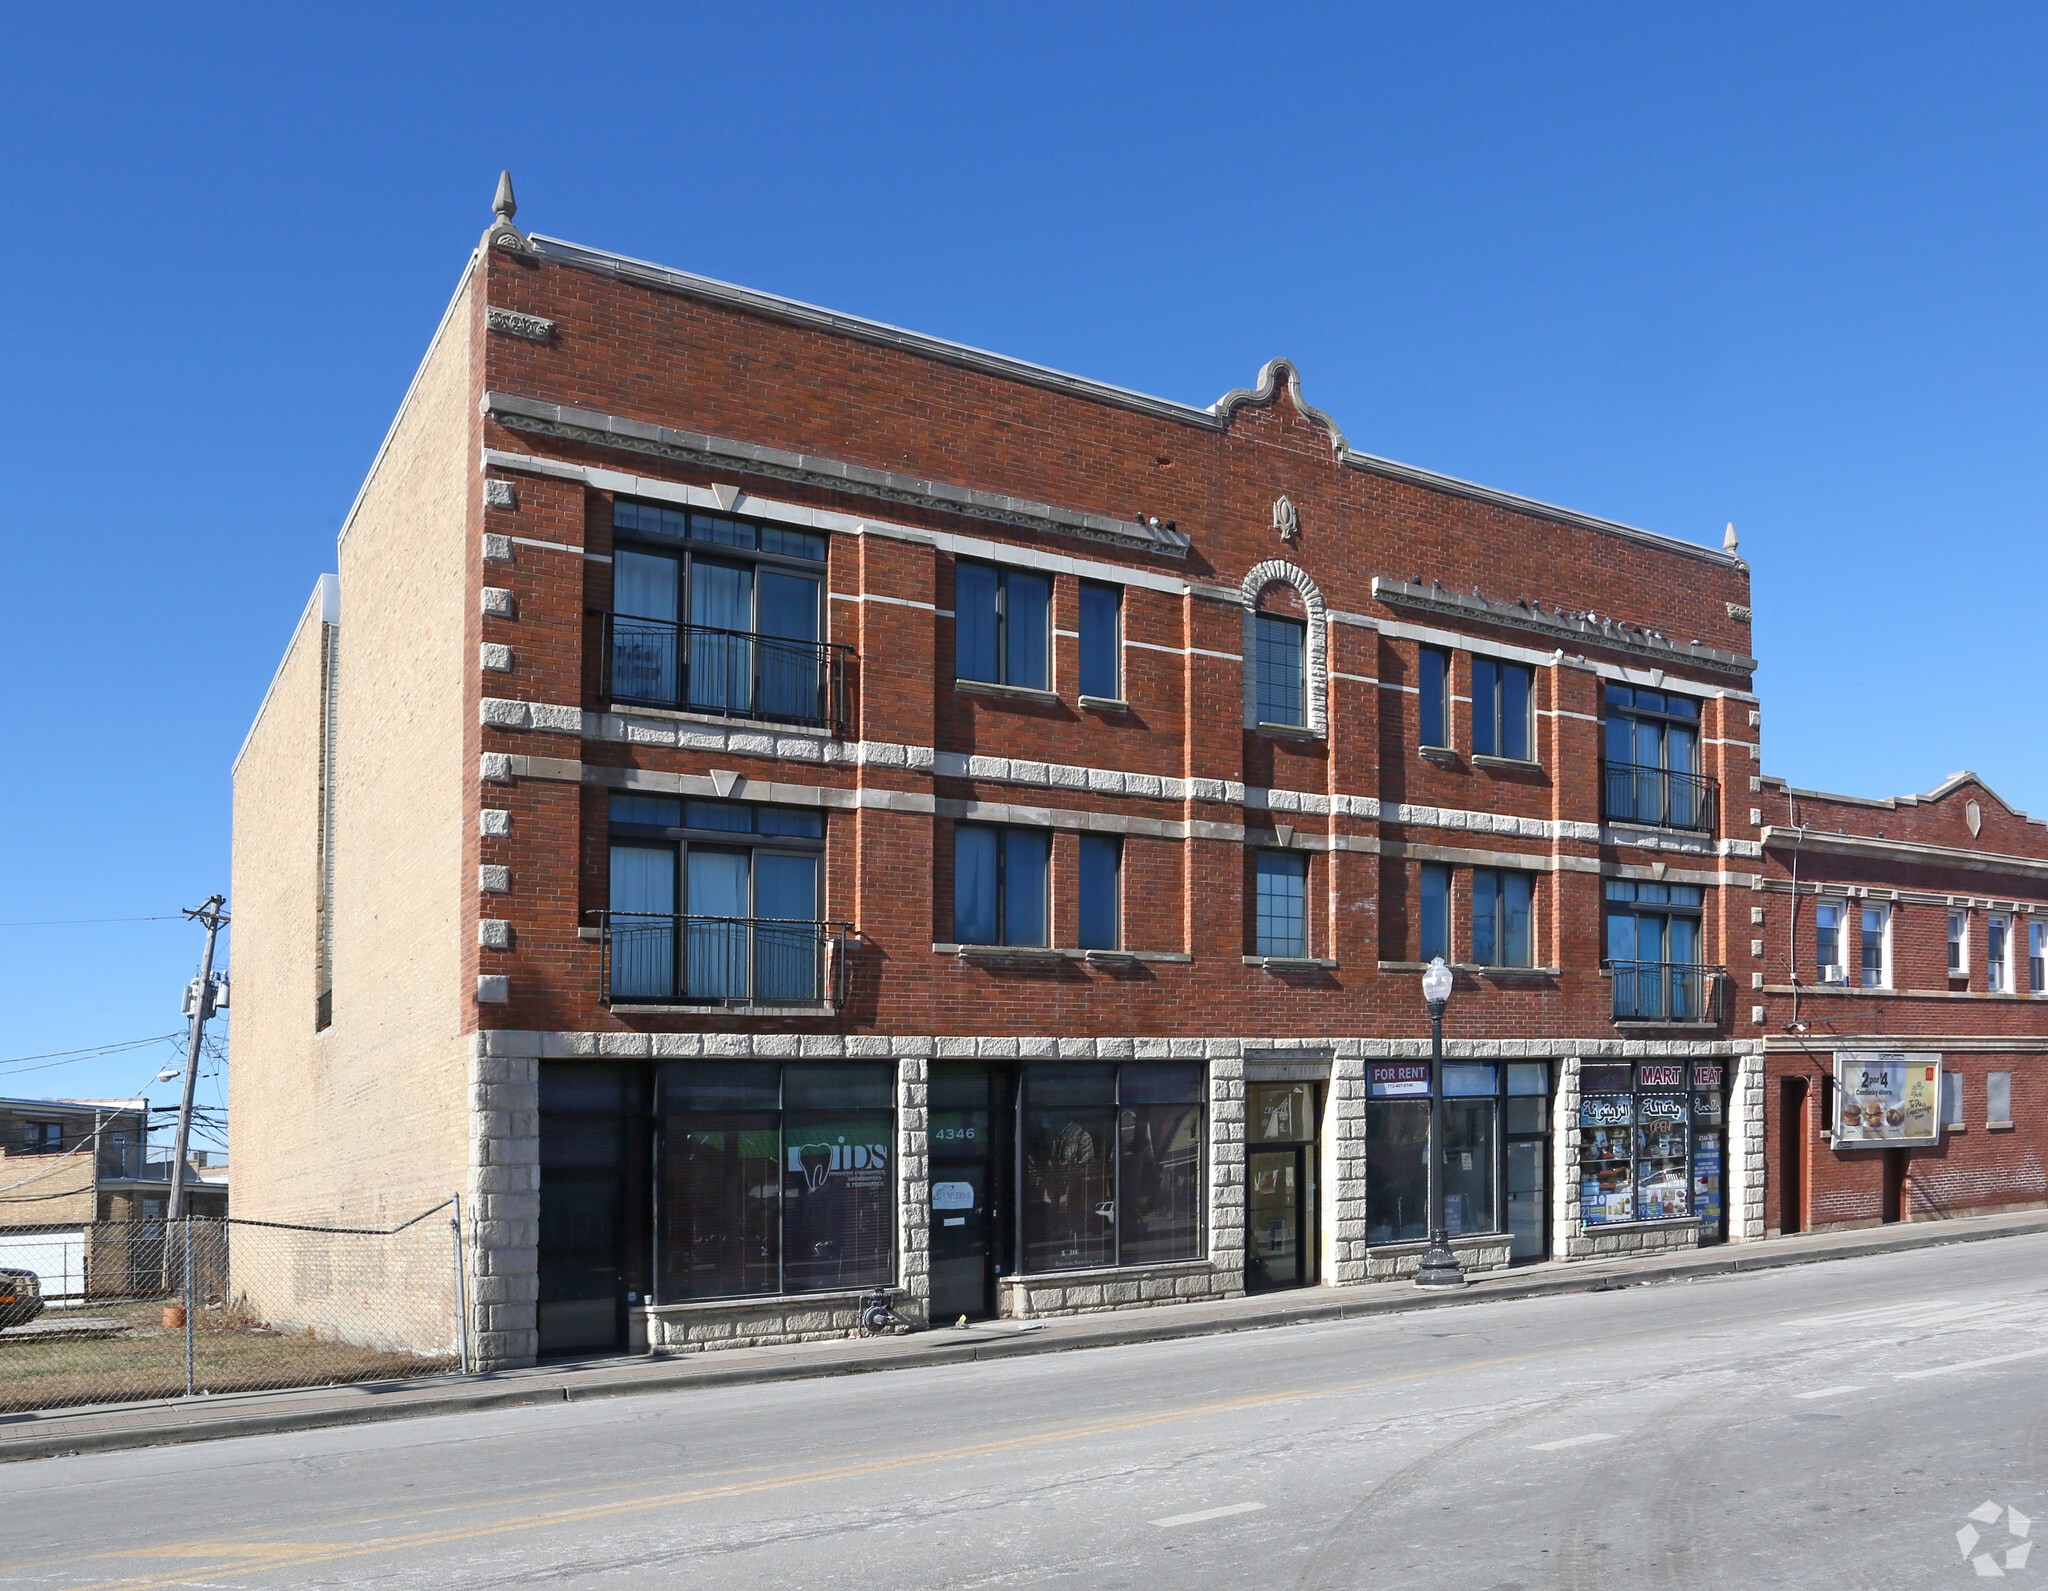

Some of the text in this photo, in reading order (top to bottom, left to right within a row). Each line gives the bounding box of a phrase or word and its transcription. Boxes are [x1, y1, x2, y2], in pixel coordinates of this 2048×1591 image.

[1374, 1066, 1425, 1080] FOR RENT
[1641, 1066, 1681, 1085] MART
[1694, 1066, 1722, 1085] MEAT
[1862, 1071, 1869, 1088] 2
[1870, 1077, 1879, 1086] por
[1582, 1098, 1681, 1122] بقالة الزيتونة
[935, 1128, 975, 1140] 4346
[1650, 1121, 1671, 1133] OPEN
[1581, 1206, 1591, 1218] 23
